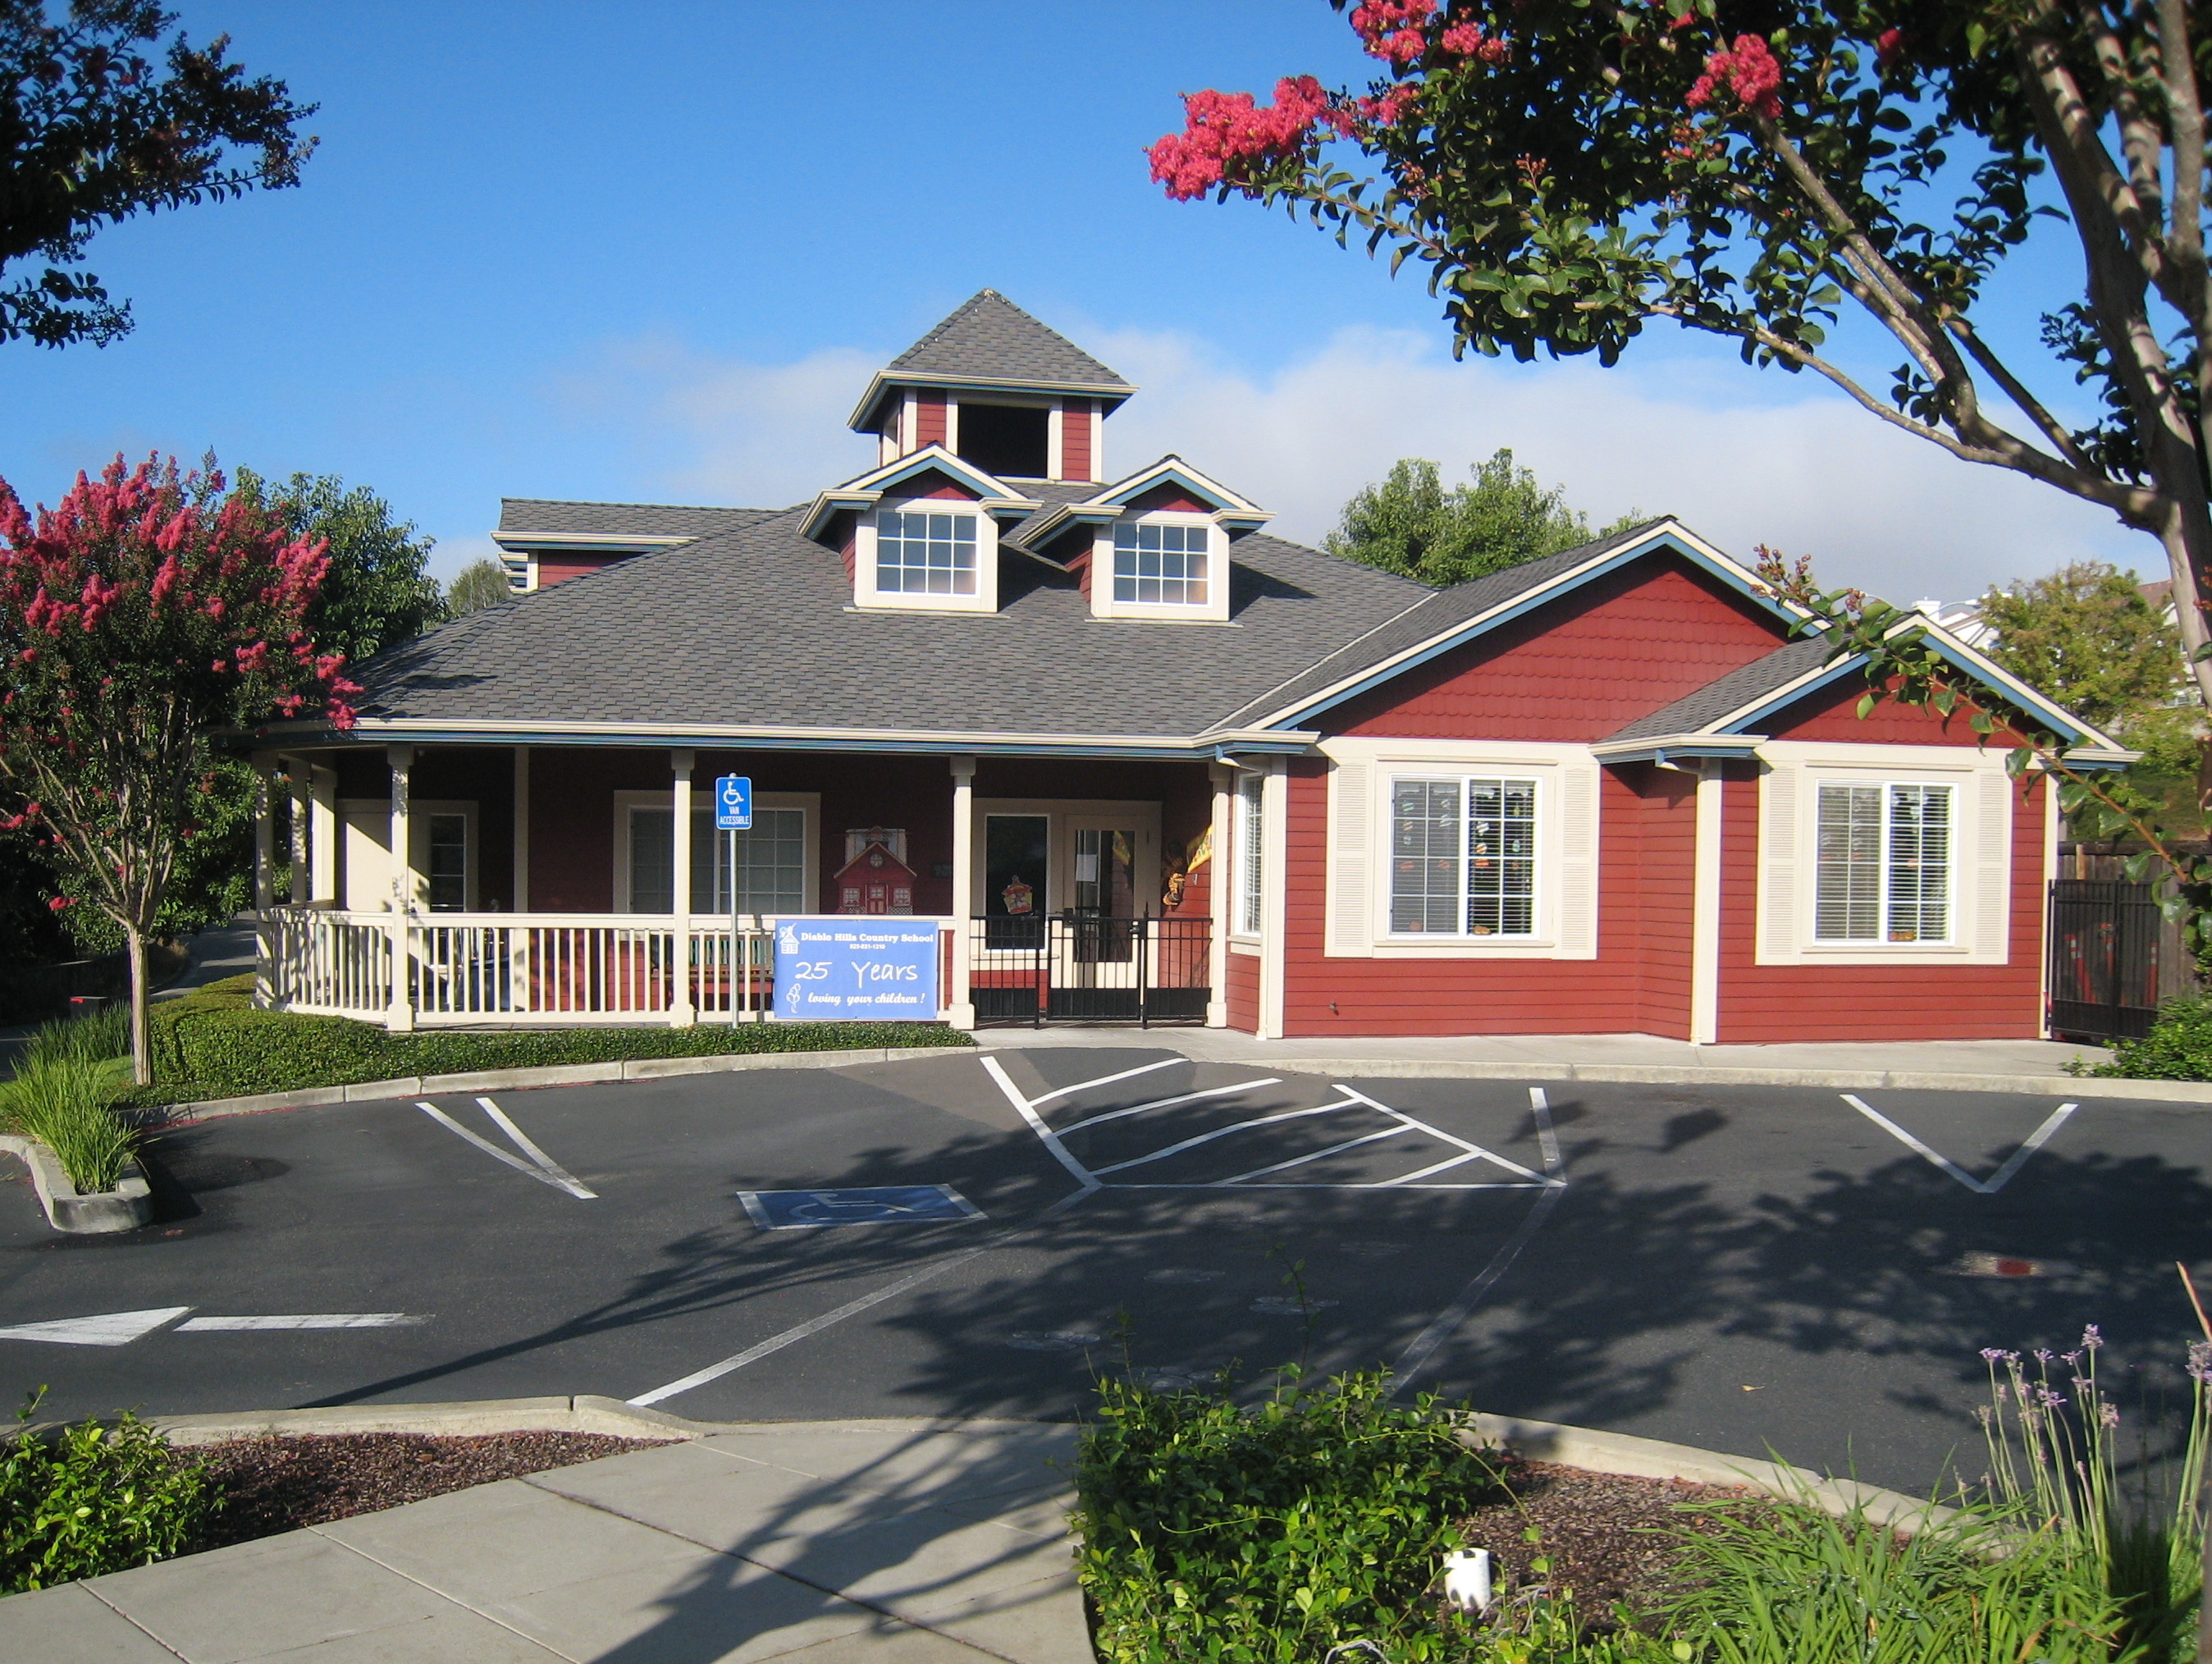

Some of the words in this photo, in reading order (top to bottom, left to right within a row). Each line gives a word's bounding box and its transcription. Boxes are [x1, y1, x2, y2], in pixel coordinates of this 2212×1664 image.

[720, 816, 749, 825] ACCESSIBLE
[801, 933, 832, 942] Diablo
[834, 933, 857, 942] Hills
[859, 933, 898, 944] Country
[901, 933, 934, 943] School
[794, 961, 834, 980] 25
[851, 961, 919, 989] Years
[807, 993, 842, 1006] loving
[846, 995, 873, 1006] your
